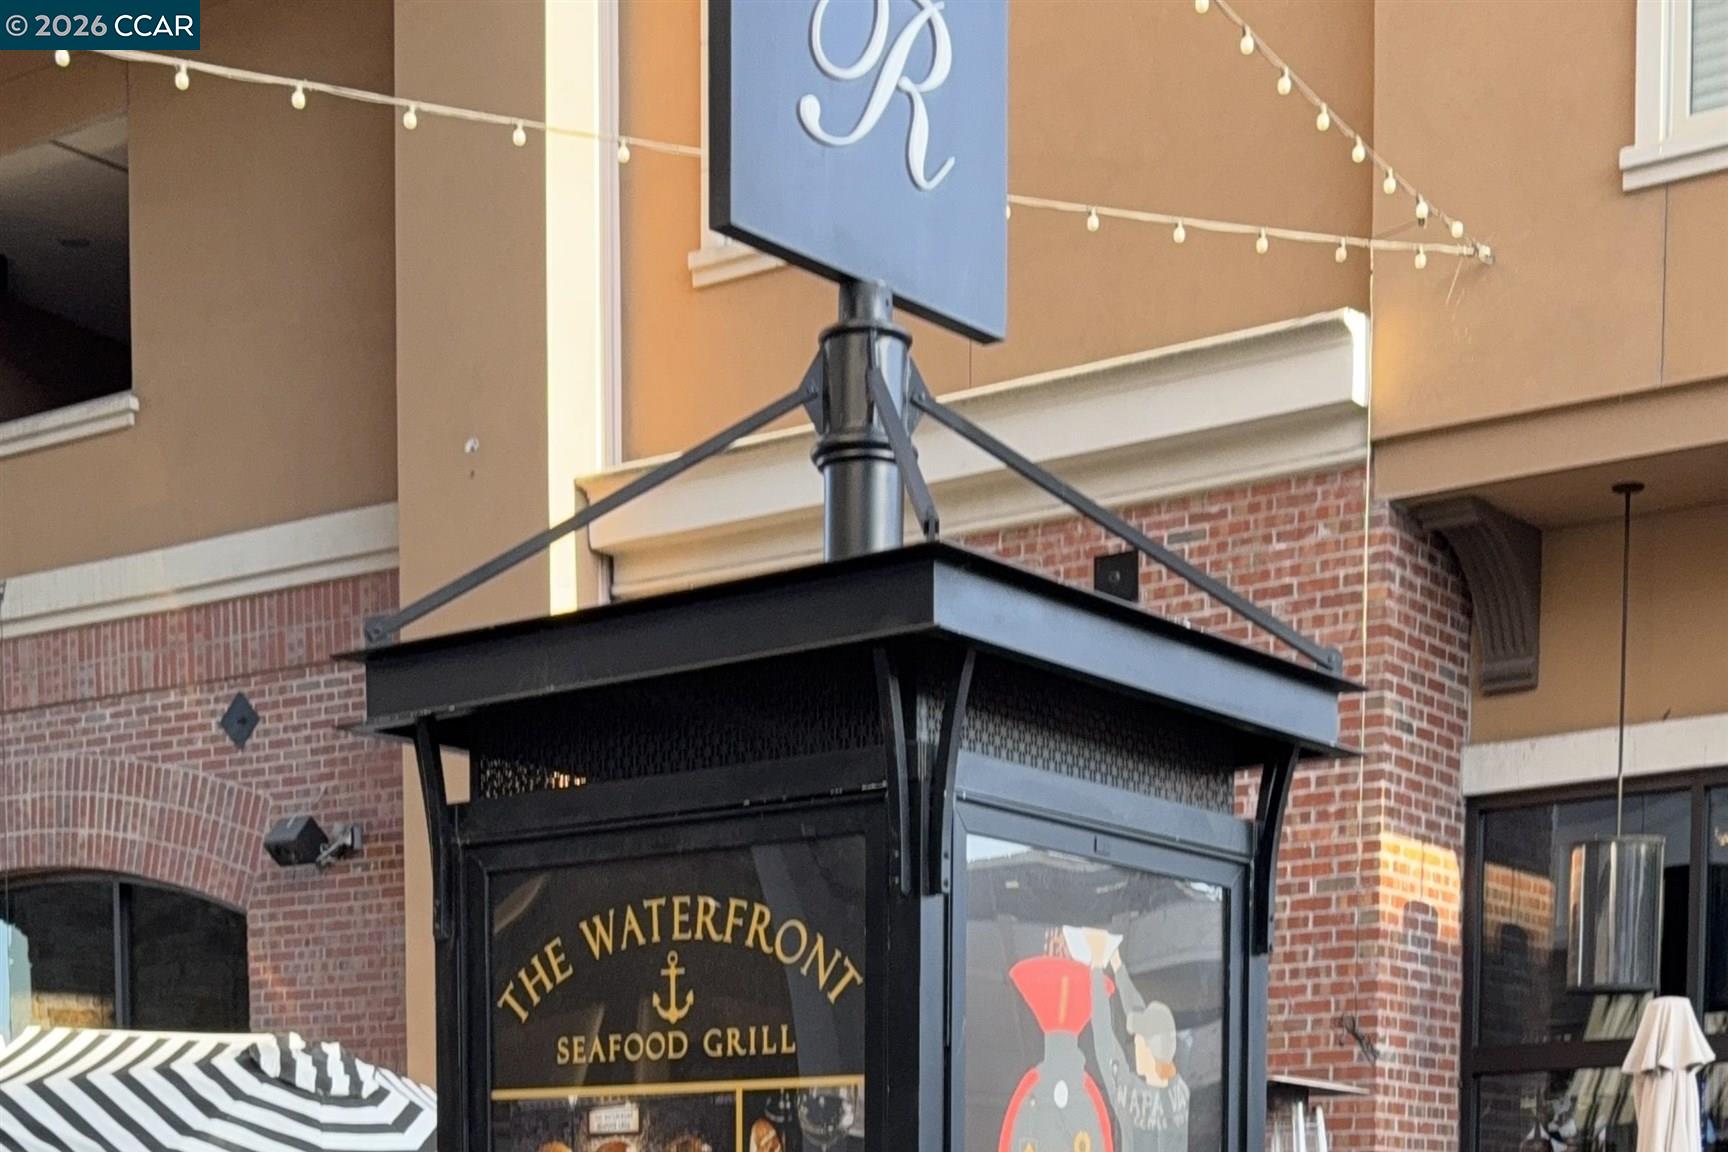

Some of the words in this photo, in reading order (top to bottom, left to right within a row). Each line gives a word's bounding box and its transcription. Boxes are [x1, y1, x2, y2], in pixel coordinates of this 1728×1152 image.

[497, 936, 574, 1024] THE
[579, 895, 864, 1005] WATERFRONT
[556, 1030, 688, 1065] SEAFOOD
[703, 1024, 796, 1059] GRILL
